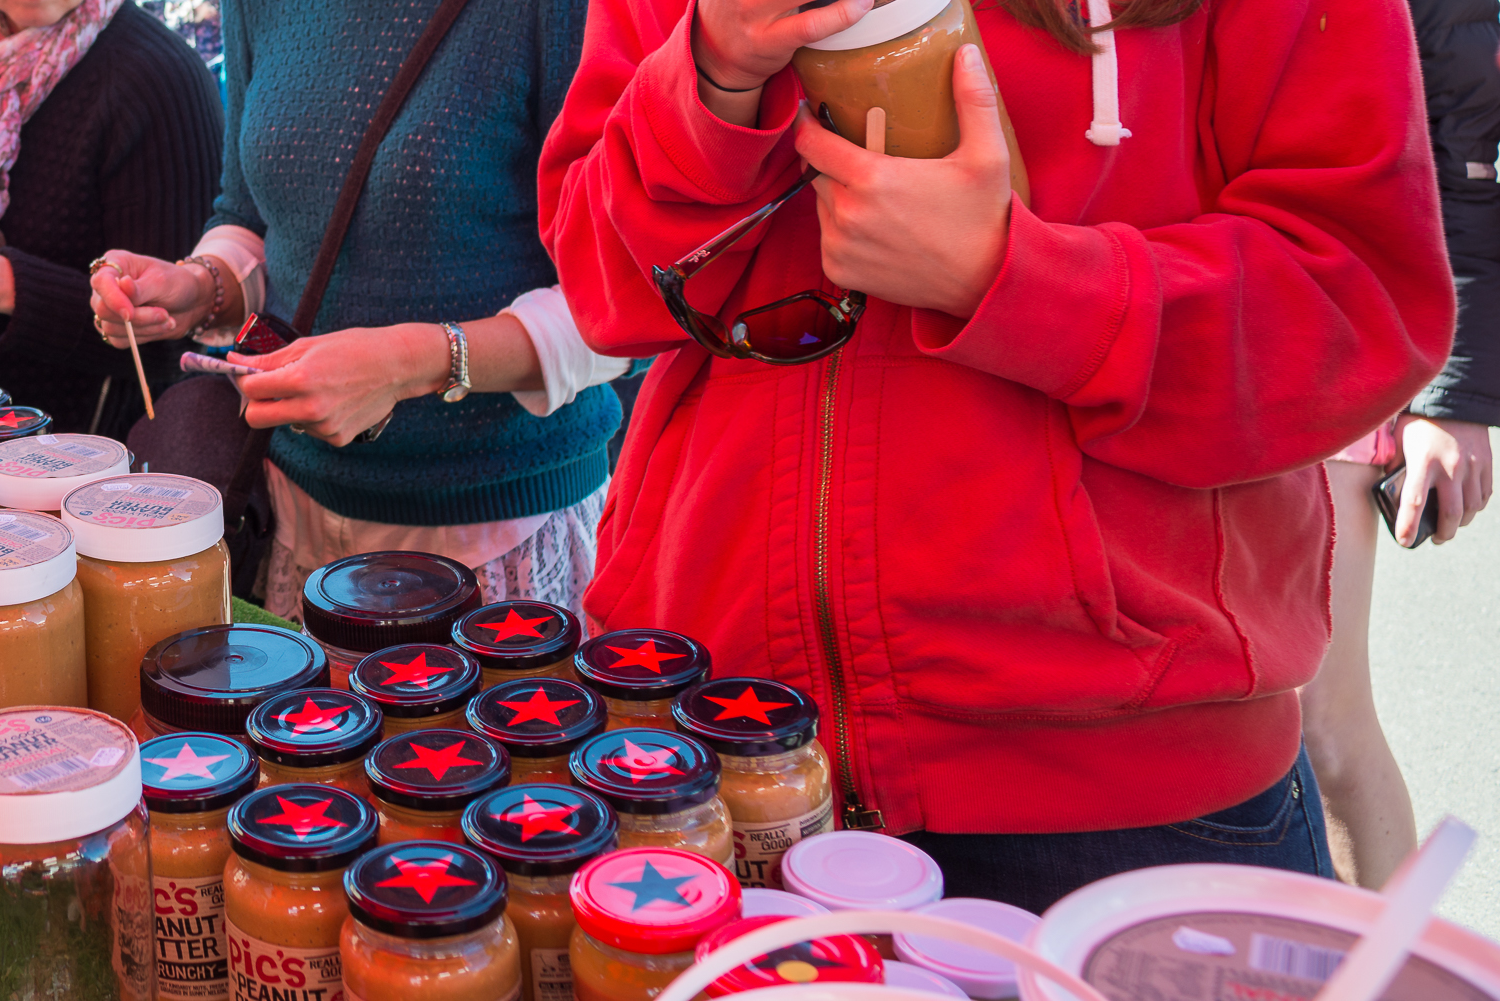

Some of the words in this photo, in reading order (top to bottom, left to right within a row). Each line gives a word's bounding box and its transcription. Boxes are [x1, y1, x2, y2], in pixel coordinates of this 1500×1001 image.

[750, 829, 786, 842] REALLY
[761, 837, 793, 851] GOOD
[155, 913, 219, 938] ANUT
[157, 936, 221, 960] TTER
[310, 956, 341, 970] REALL
[158, 963, 217, 980] RUNCHY
